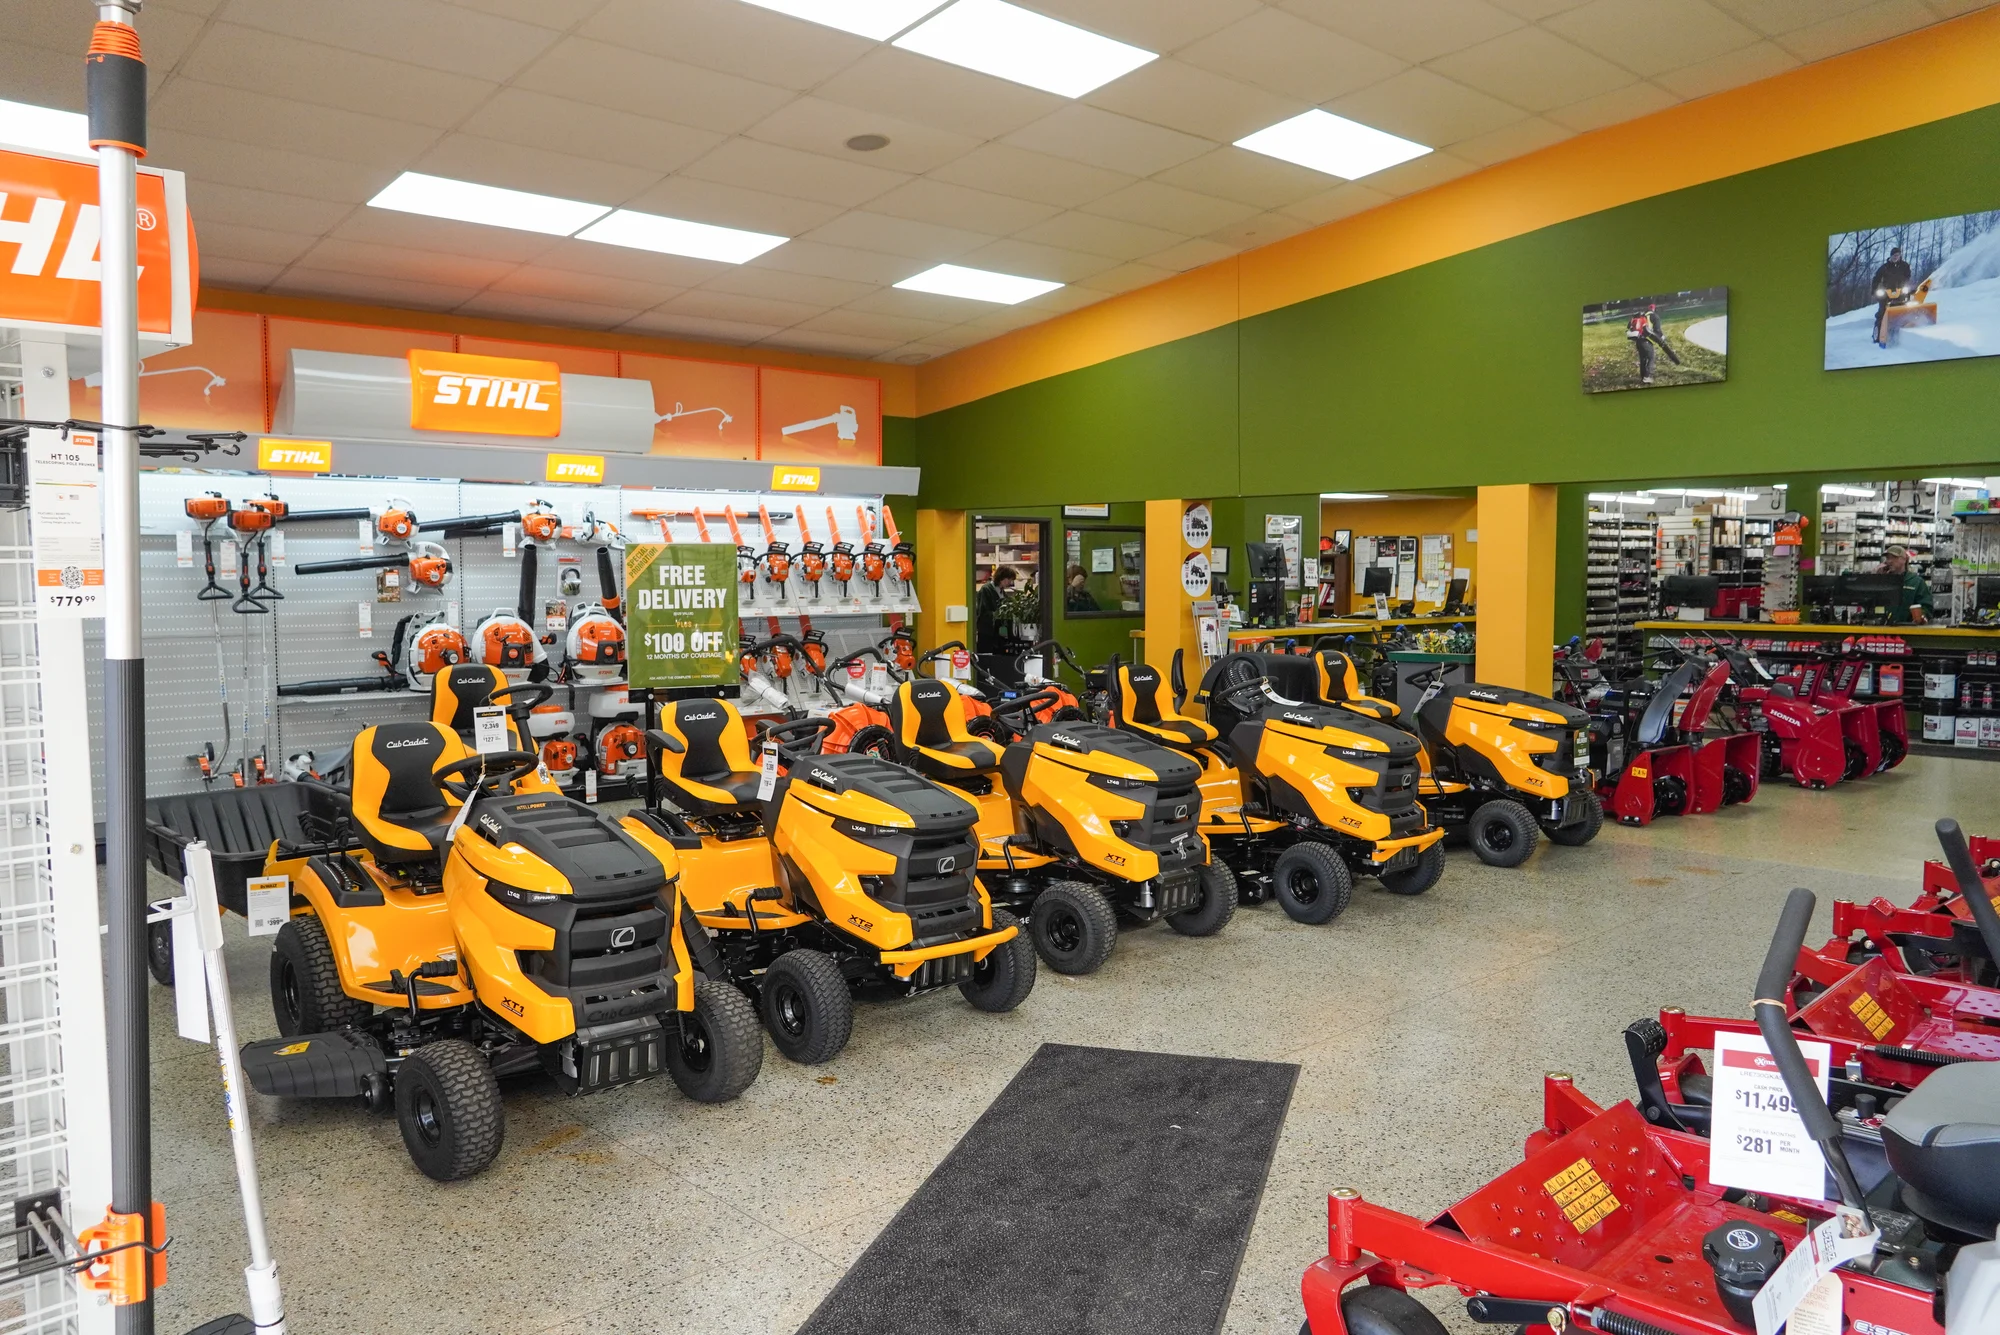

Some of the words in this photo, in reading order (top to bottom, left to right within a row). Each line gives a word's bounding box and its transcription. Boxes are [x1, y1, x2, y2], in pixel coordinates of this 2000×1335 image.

[433, 375, 551, 411] STIHL
[268, 449, 325, 465] STIHL
[555, 462, 599, 477] STIHL
[780, 473, 817, 486] STIHL
[626, 546, 649, 569] SPECIAL
[628, 546, 659, 579] PROMOTION
[659, 565, 706, 586] FREE
[638, 588, 727, 610] DELIVERY
[676, 620, 692, 628] PLUS
[644, 631, 685, 654] $100
[690, 630, 723, 653] OFF
[467, 676, 486, 684] Cadet
[1480, 691, 1499, 700] Cadet
[684, 713, 695, 722] Cub
[695, 711, 717, 721] Cadet
[1283, 711, 1295, 719] Cub
[1294, 713, 1314, 723] Cadet
[1769, 708, 1801, 727] HONDA
[386, 741, 403, 749] Cub
[402, 737, 430, 748] Cadet
[1052, 732, 1063, 741] Cub
[1062, 735, 1082, 746] Cadet
[810, 768, 822, 778] Cub
[820, 772, 838, 785] Cadet
[516, 802, 547, 811] INTELLIPOWER
[479, 813, 490, 826] Cub
[487, 818, 503, 834] Cadet
[1342, 815, 1363, 826] XT2
[1106, 852, 1126, 864] XT1
[507, 889, 520, 900] LT42
[850, 913, 874, 929] XT2
[502, 996, 525, 1013] XT1
[1770, 1131, 1797, 1139] MONTHS
[1736, 1134, 1772, 1155] $281
[1779, 1147, 1800, 1155] MONTH
